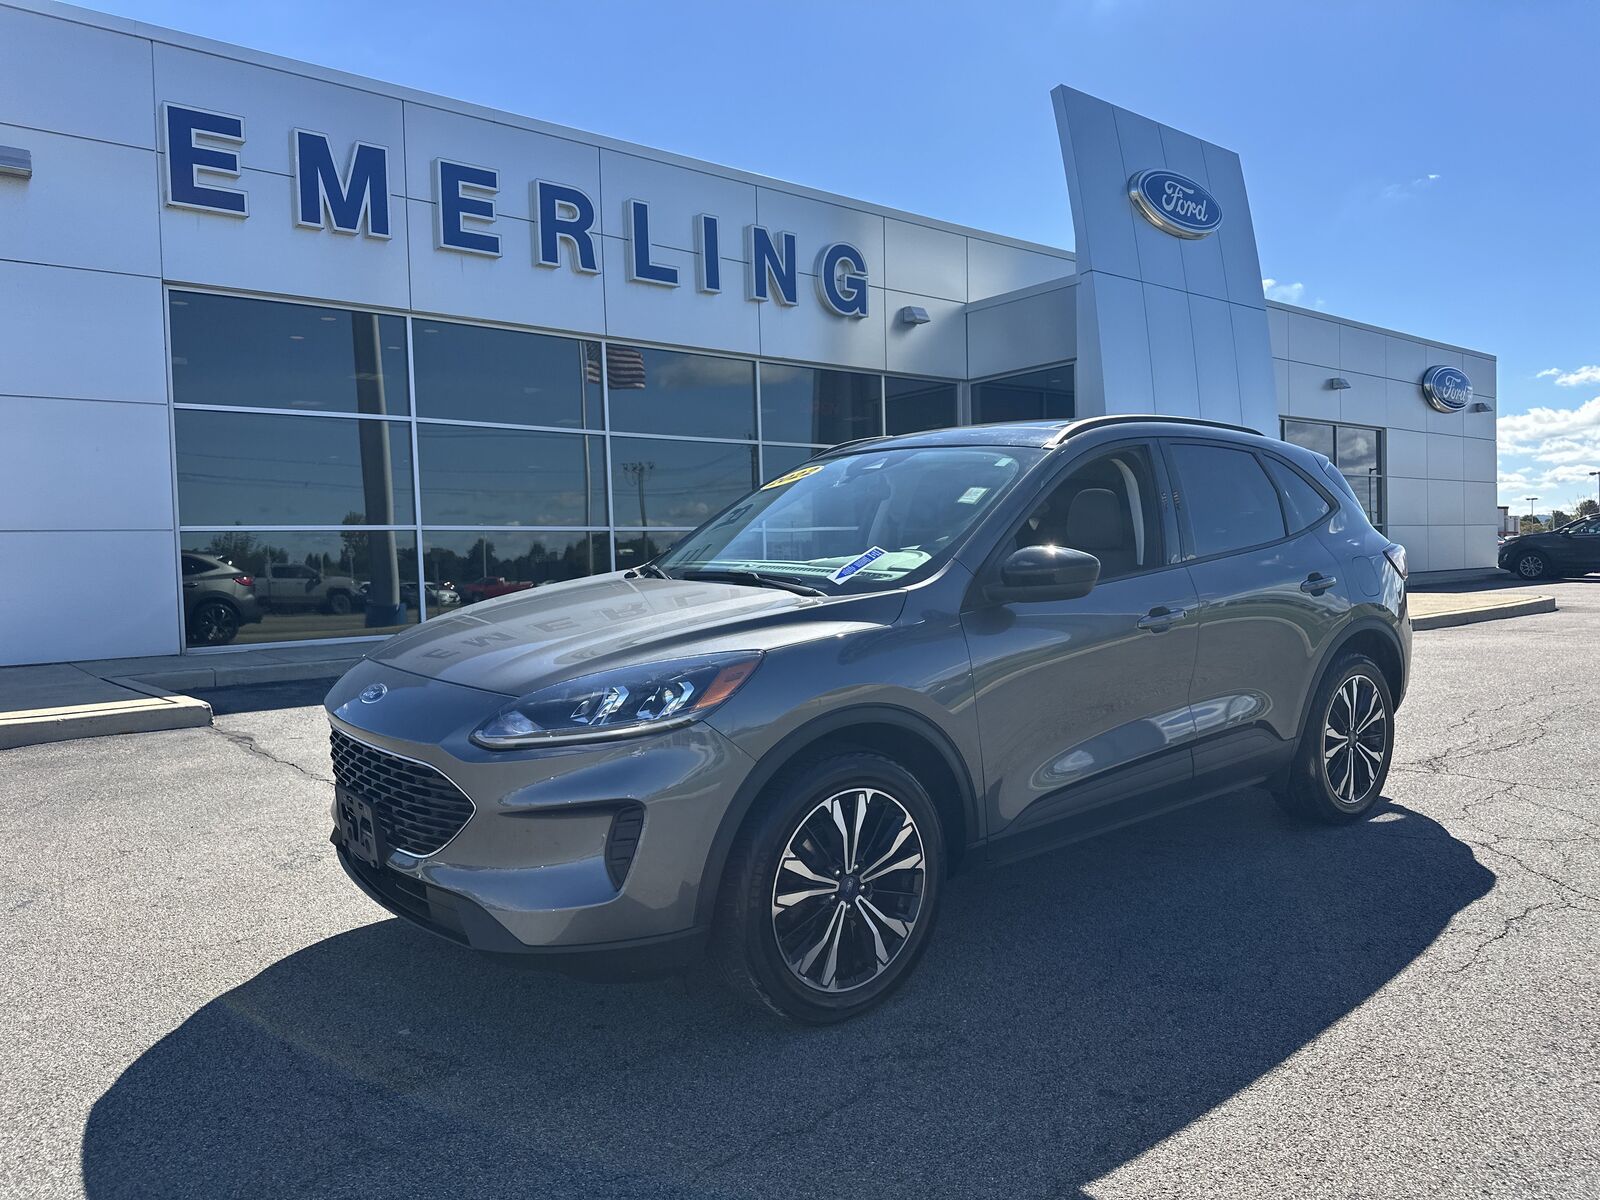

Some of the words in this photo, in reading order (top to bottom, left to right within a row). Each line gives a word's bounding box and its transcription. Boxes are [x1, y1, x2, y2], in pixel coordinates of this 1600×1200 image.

[162, 100, 868, 317] EMERLING
[1162, 180, 1208, 222] Ford
[1443, 375, 1467, 401] Ford
